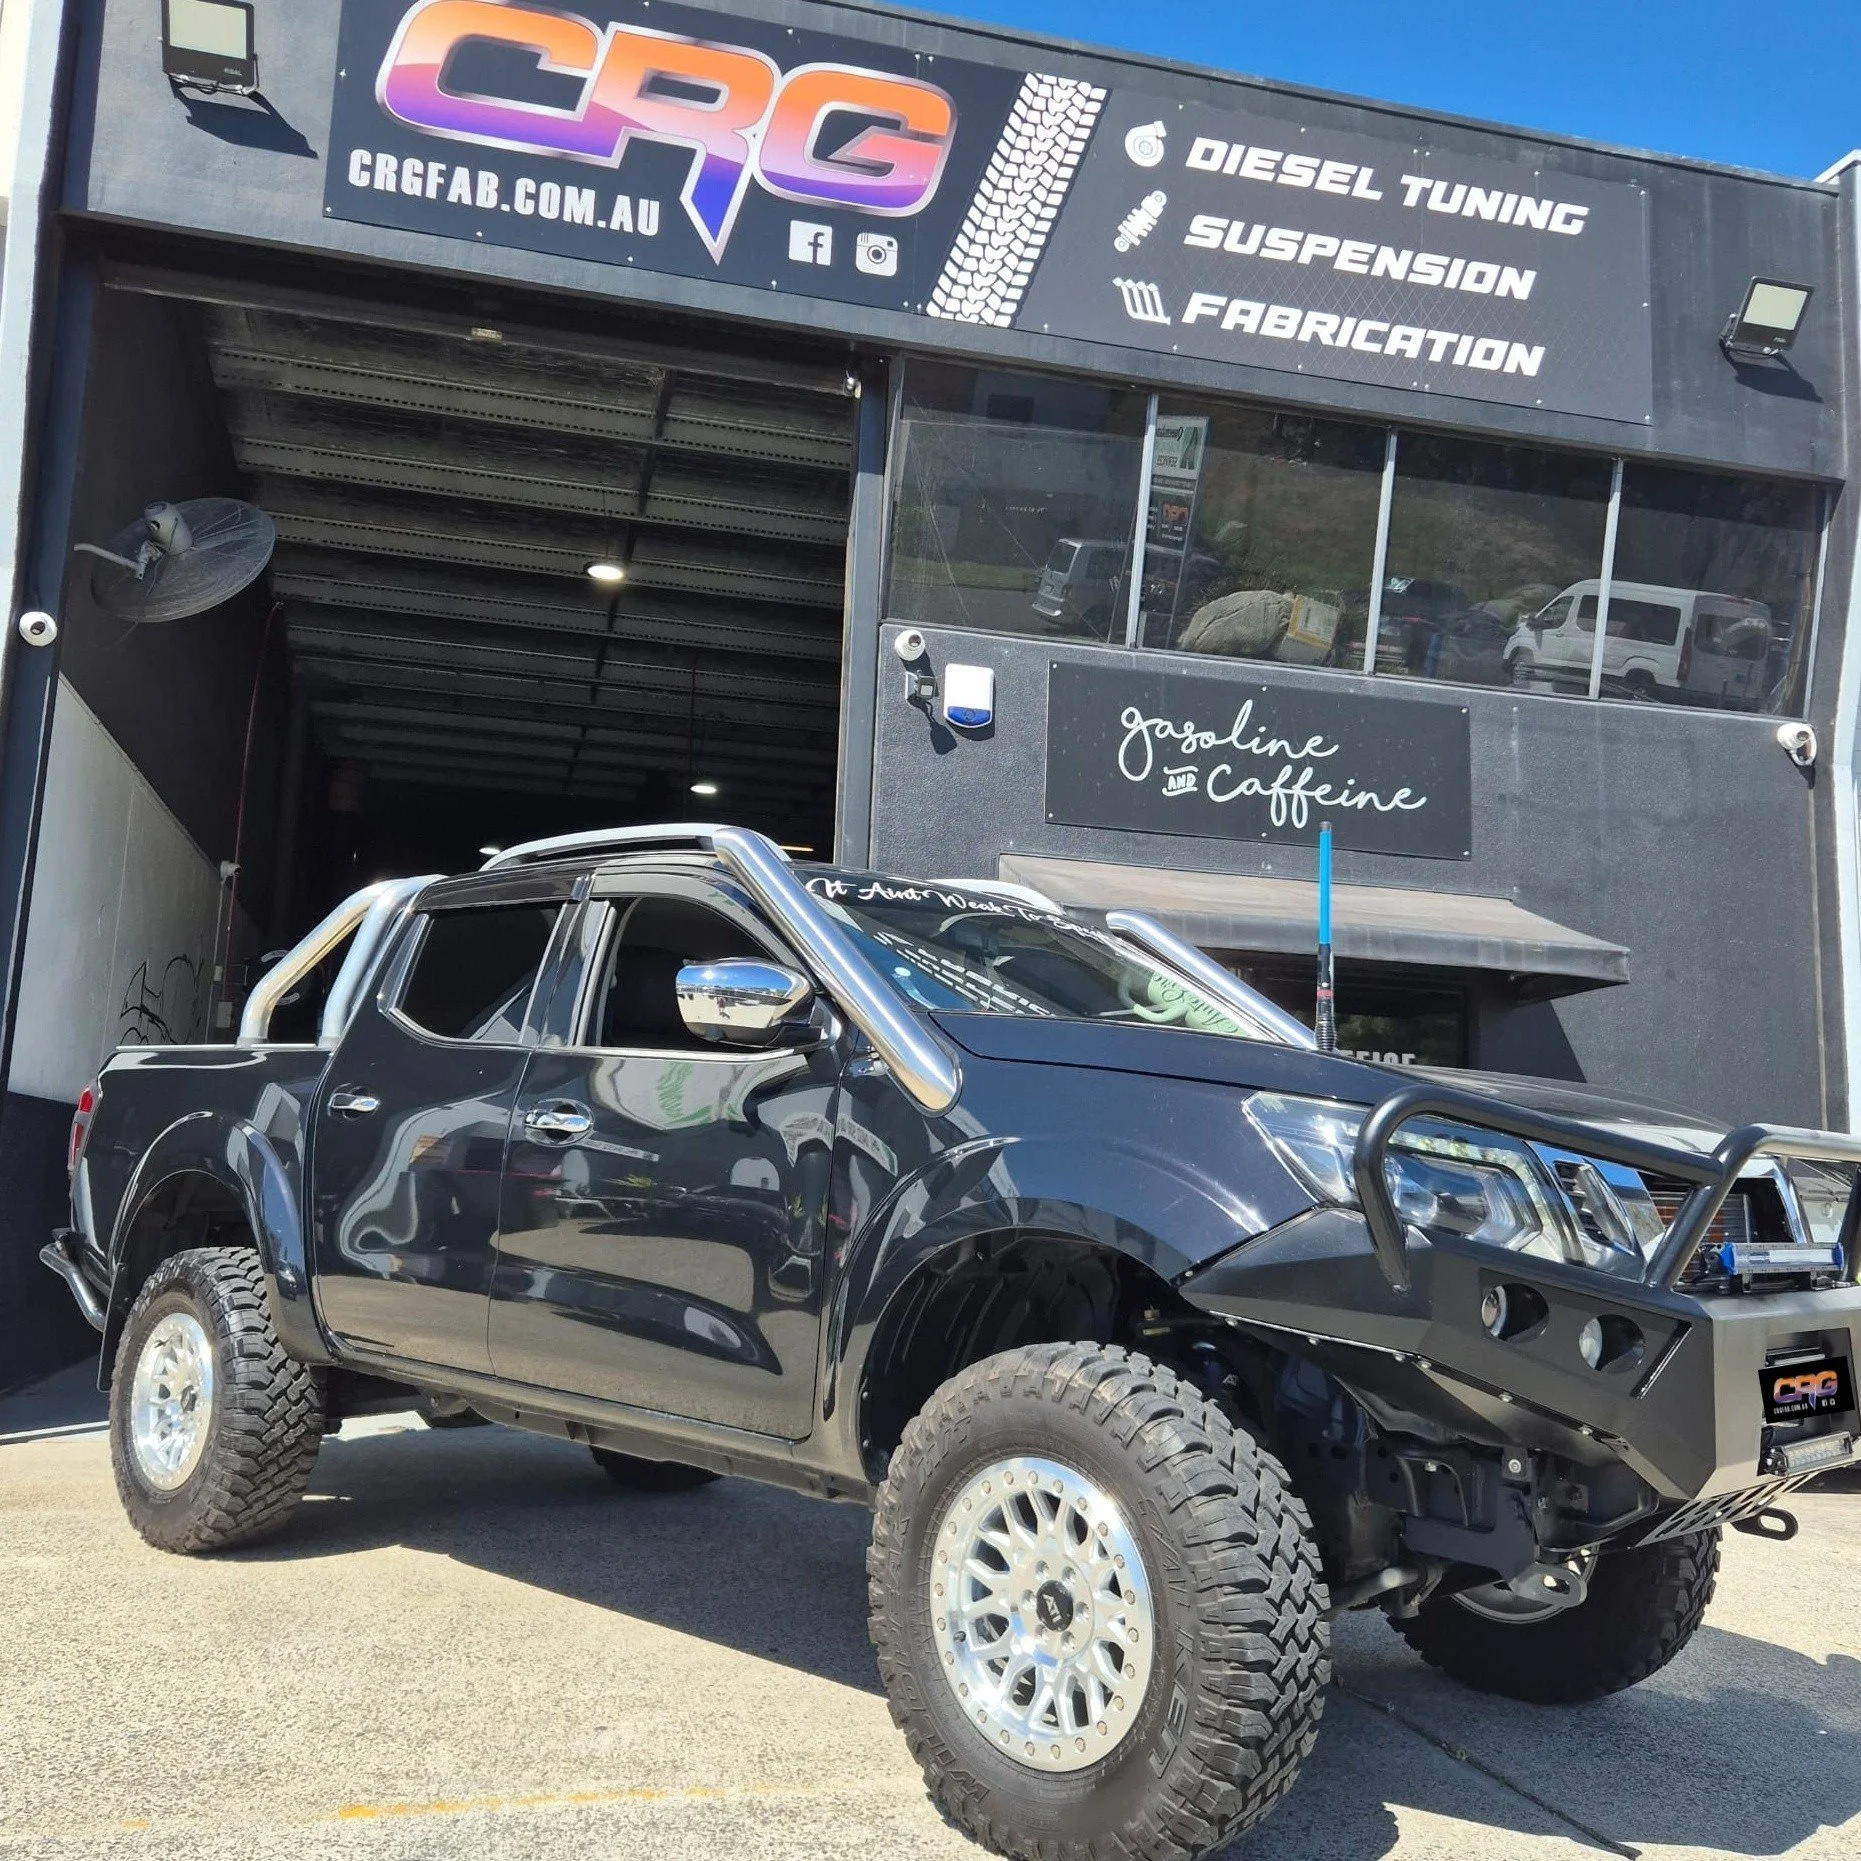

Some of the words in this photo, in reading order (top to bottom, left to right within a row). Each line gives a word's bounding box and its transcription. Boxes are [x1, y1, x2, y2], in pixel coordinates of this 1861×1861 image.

[375, 0, 957, 265] CRG
[348, 149, 660, 236] CRGFAB.COM.AU
[1186, 136, 1383, 200] DIESEL
[1400, 174, 1590, 235] TUNING
[1183, 214, 1538, 300] SUSPENSION
[1182, 292, 1546, 377] FABRICATION
[1118, 699, 1340, 782] gasoline
[1167, 773, 1197, 791] AND
[1773, 1370, 1839, 1410] CRG
